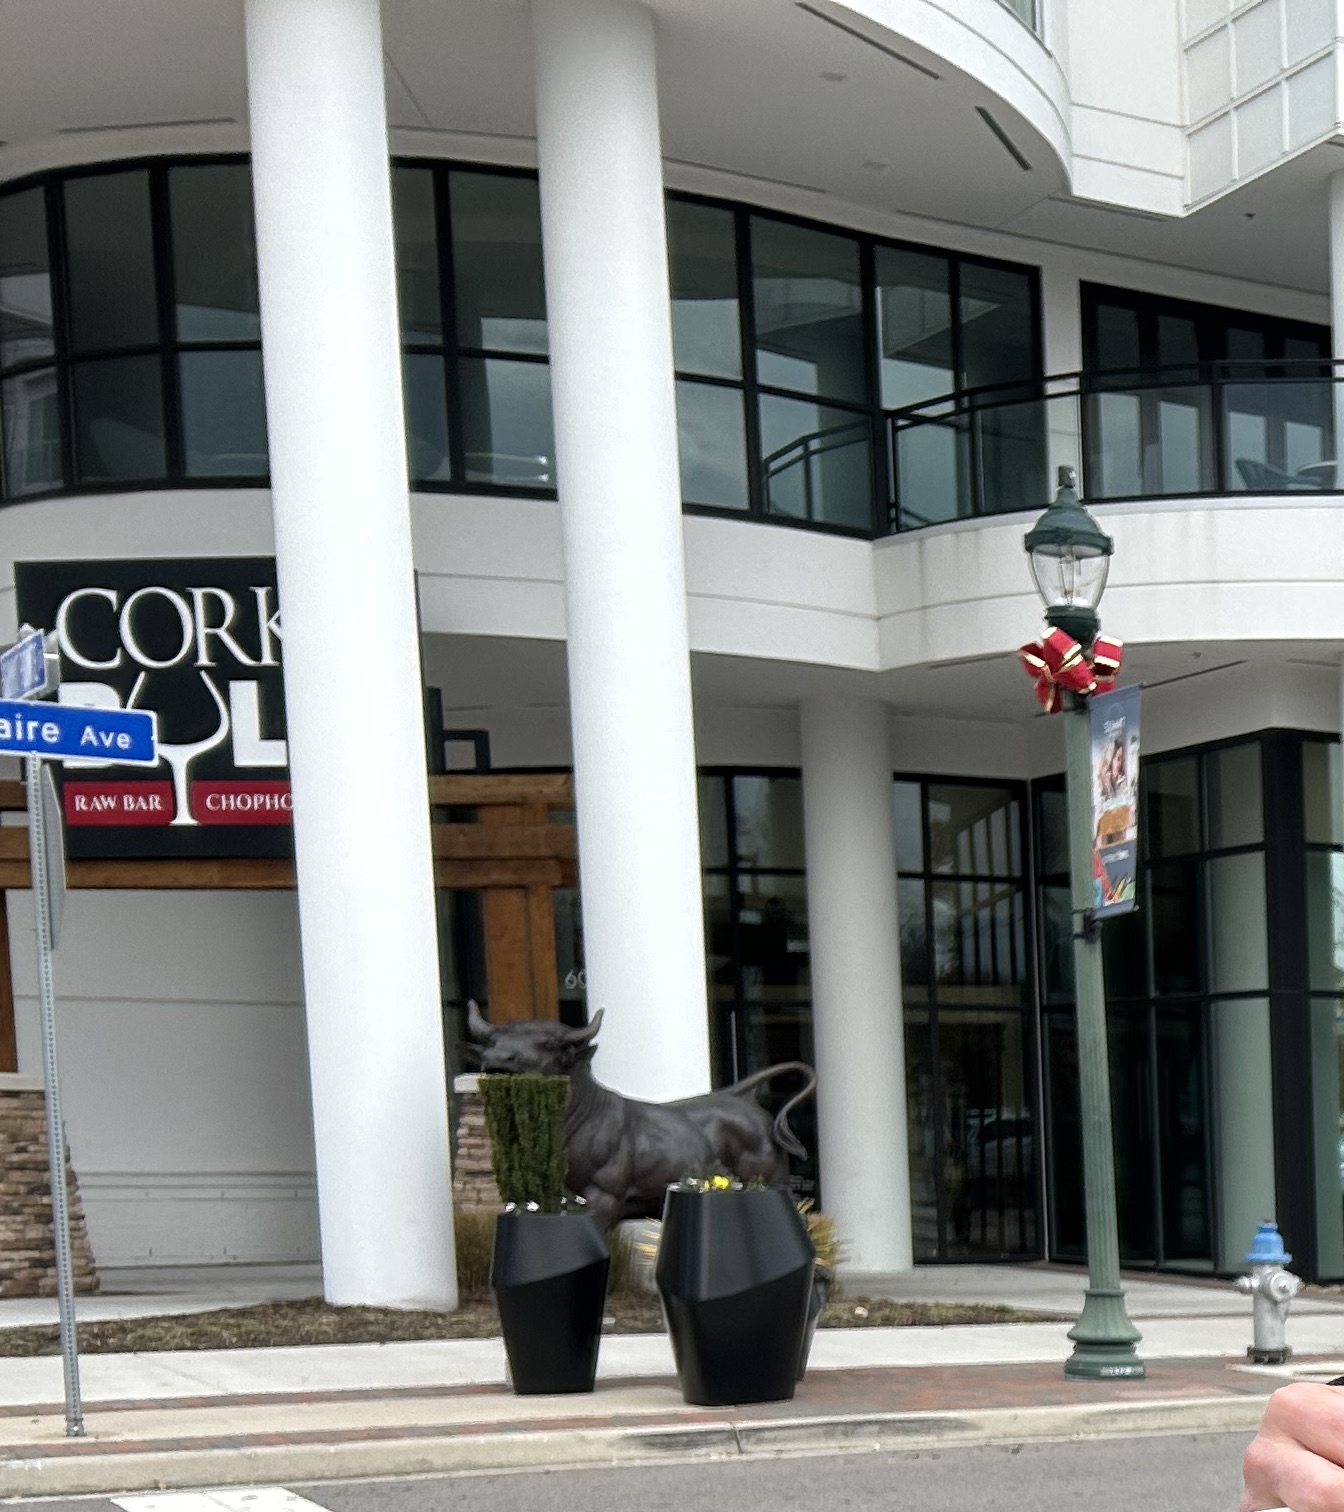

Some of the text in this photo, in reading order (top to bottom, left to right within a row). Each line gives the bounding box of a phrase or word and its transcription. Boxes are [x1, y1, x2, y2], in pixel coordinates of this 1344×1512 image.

[80, 725, 132, 749] Ave
[74, 794, 117, 811] RAW
[123, 794, 163, 811] BAR
